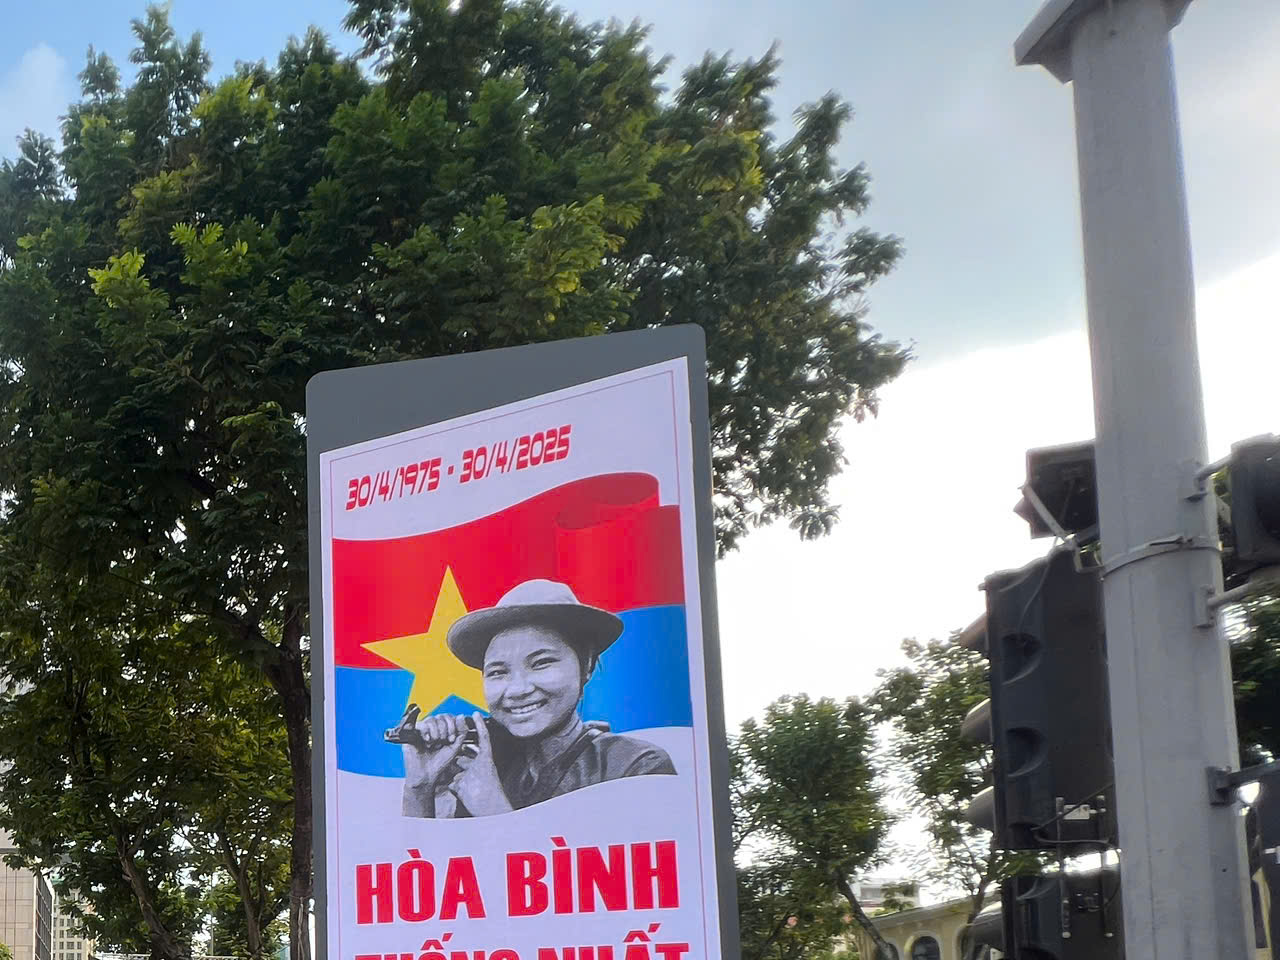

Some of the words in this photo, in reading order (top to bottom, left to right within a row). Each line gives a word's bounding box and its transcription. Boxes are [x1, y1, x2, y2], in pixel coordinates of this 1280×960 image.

[345, 457, 442, 511] 30/4/1975
[459, 424, 572, 484] 30/4/2025
[355, 848, 487, 925] HÒA
[505, 836, 680, 917] BÌNH
